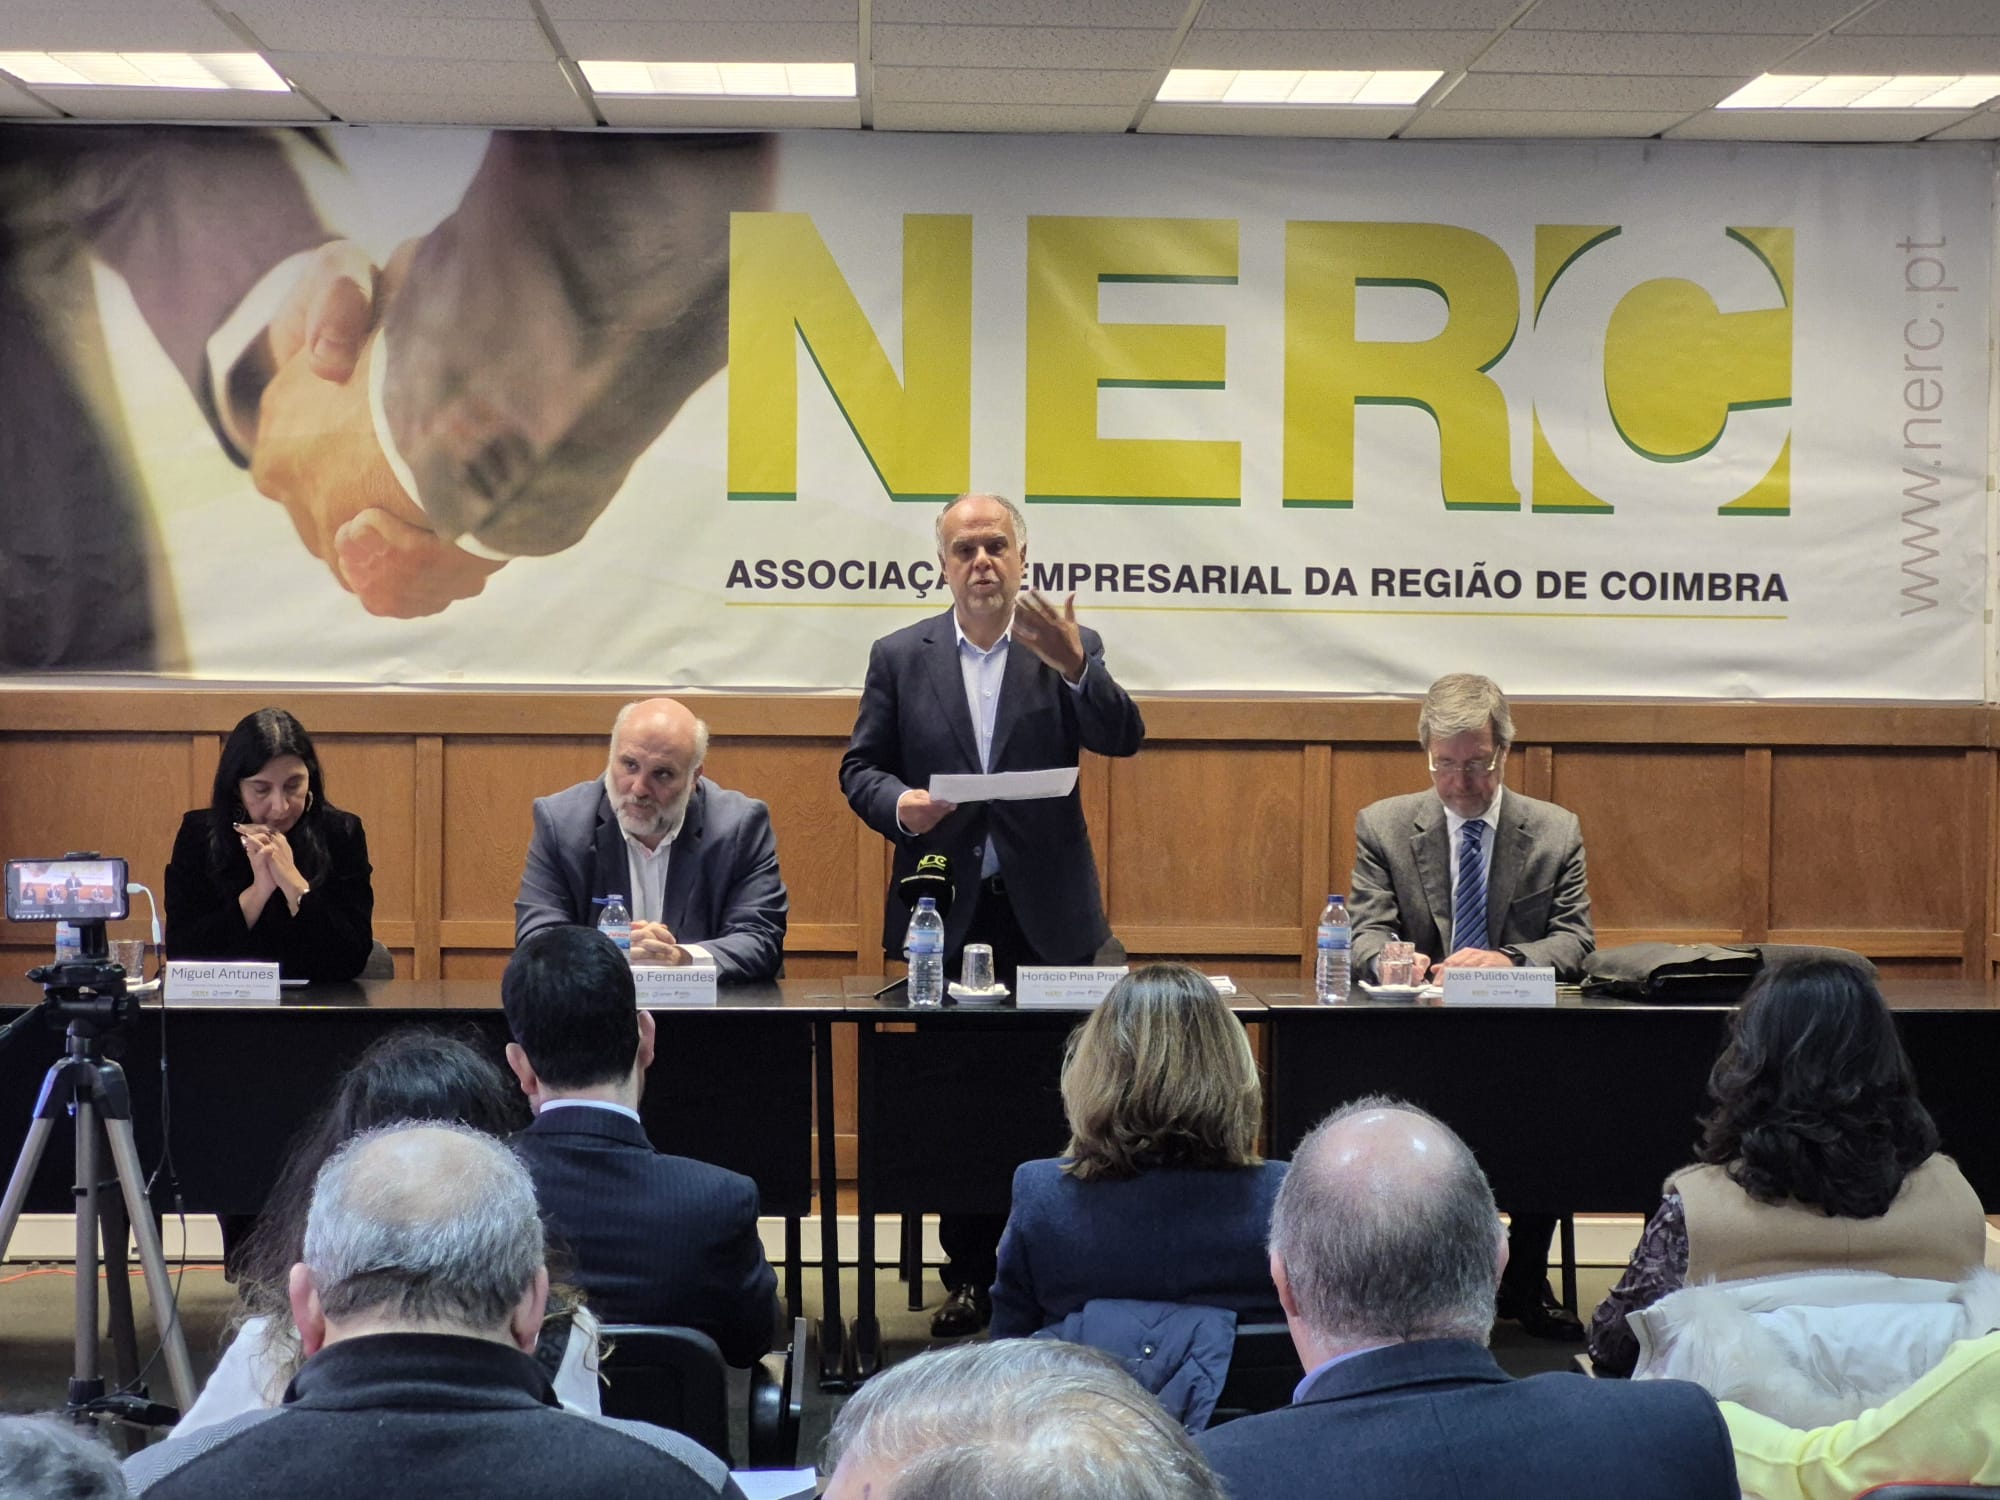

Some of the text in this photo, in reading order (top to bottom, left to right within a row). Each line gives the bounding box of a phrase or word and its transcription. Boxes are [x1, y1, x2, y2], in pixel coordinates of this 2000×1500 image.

[727, 211, 1794, 516] NERC
[1895, 235, 1959, 617] www.nerc.pt
[726, 559, 949, 600] ASSOCIAÇ
[1305, 567, 1358, 596] DA
[1371, 560, 1522, 599] REGIÃO
[1536, 570, 1587, 600] DE
[1600, 571, 1788, 602] COIMBRA
[171, 967, 274, 981] Miguel Antunes
[647, 971, 715, 983] Fernandes
[1022, 971, 1067, 982] Horácio
[1069, 971, 1094, 981] Pina
[1447, 971, 1554, 981] José Pulido Valente
